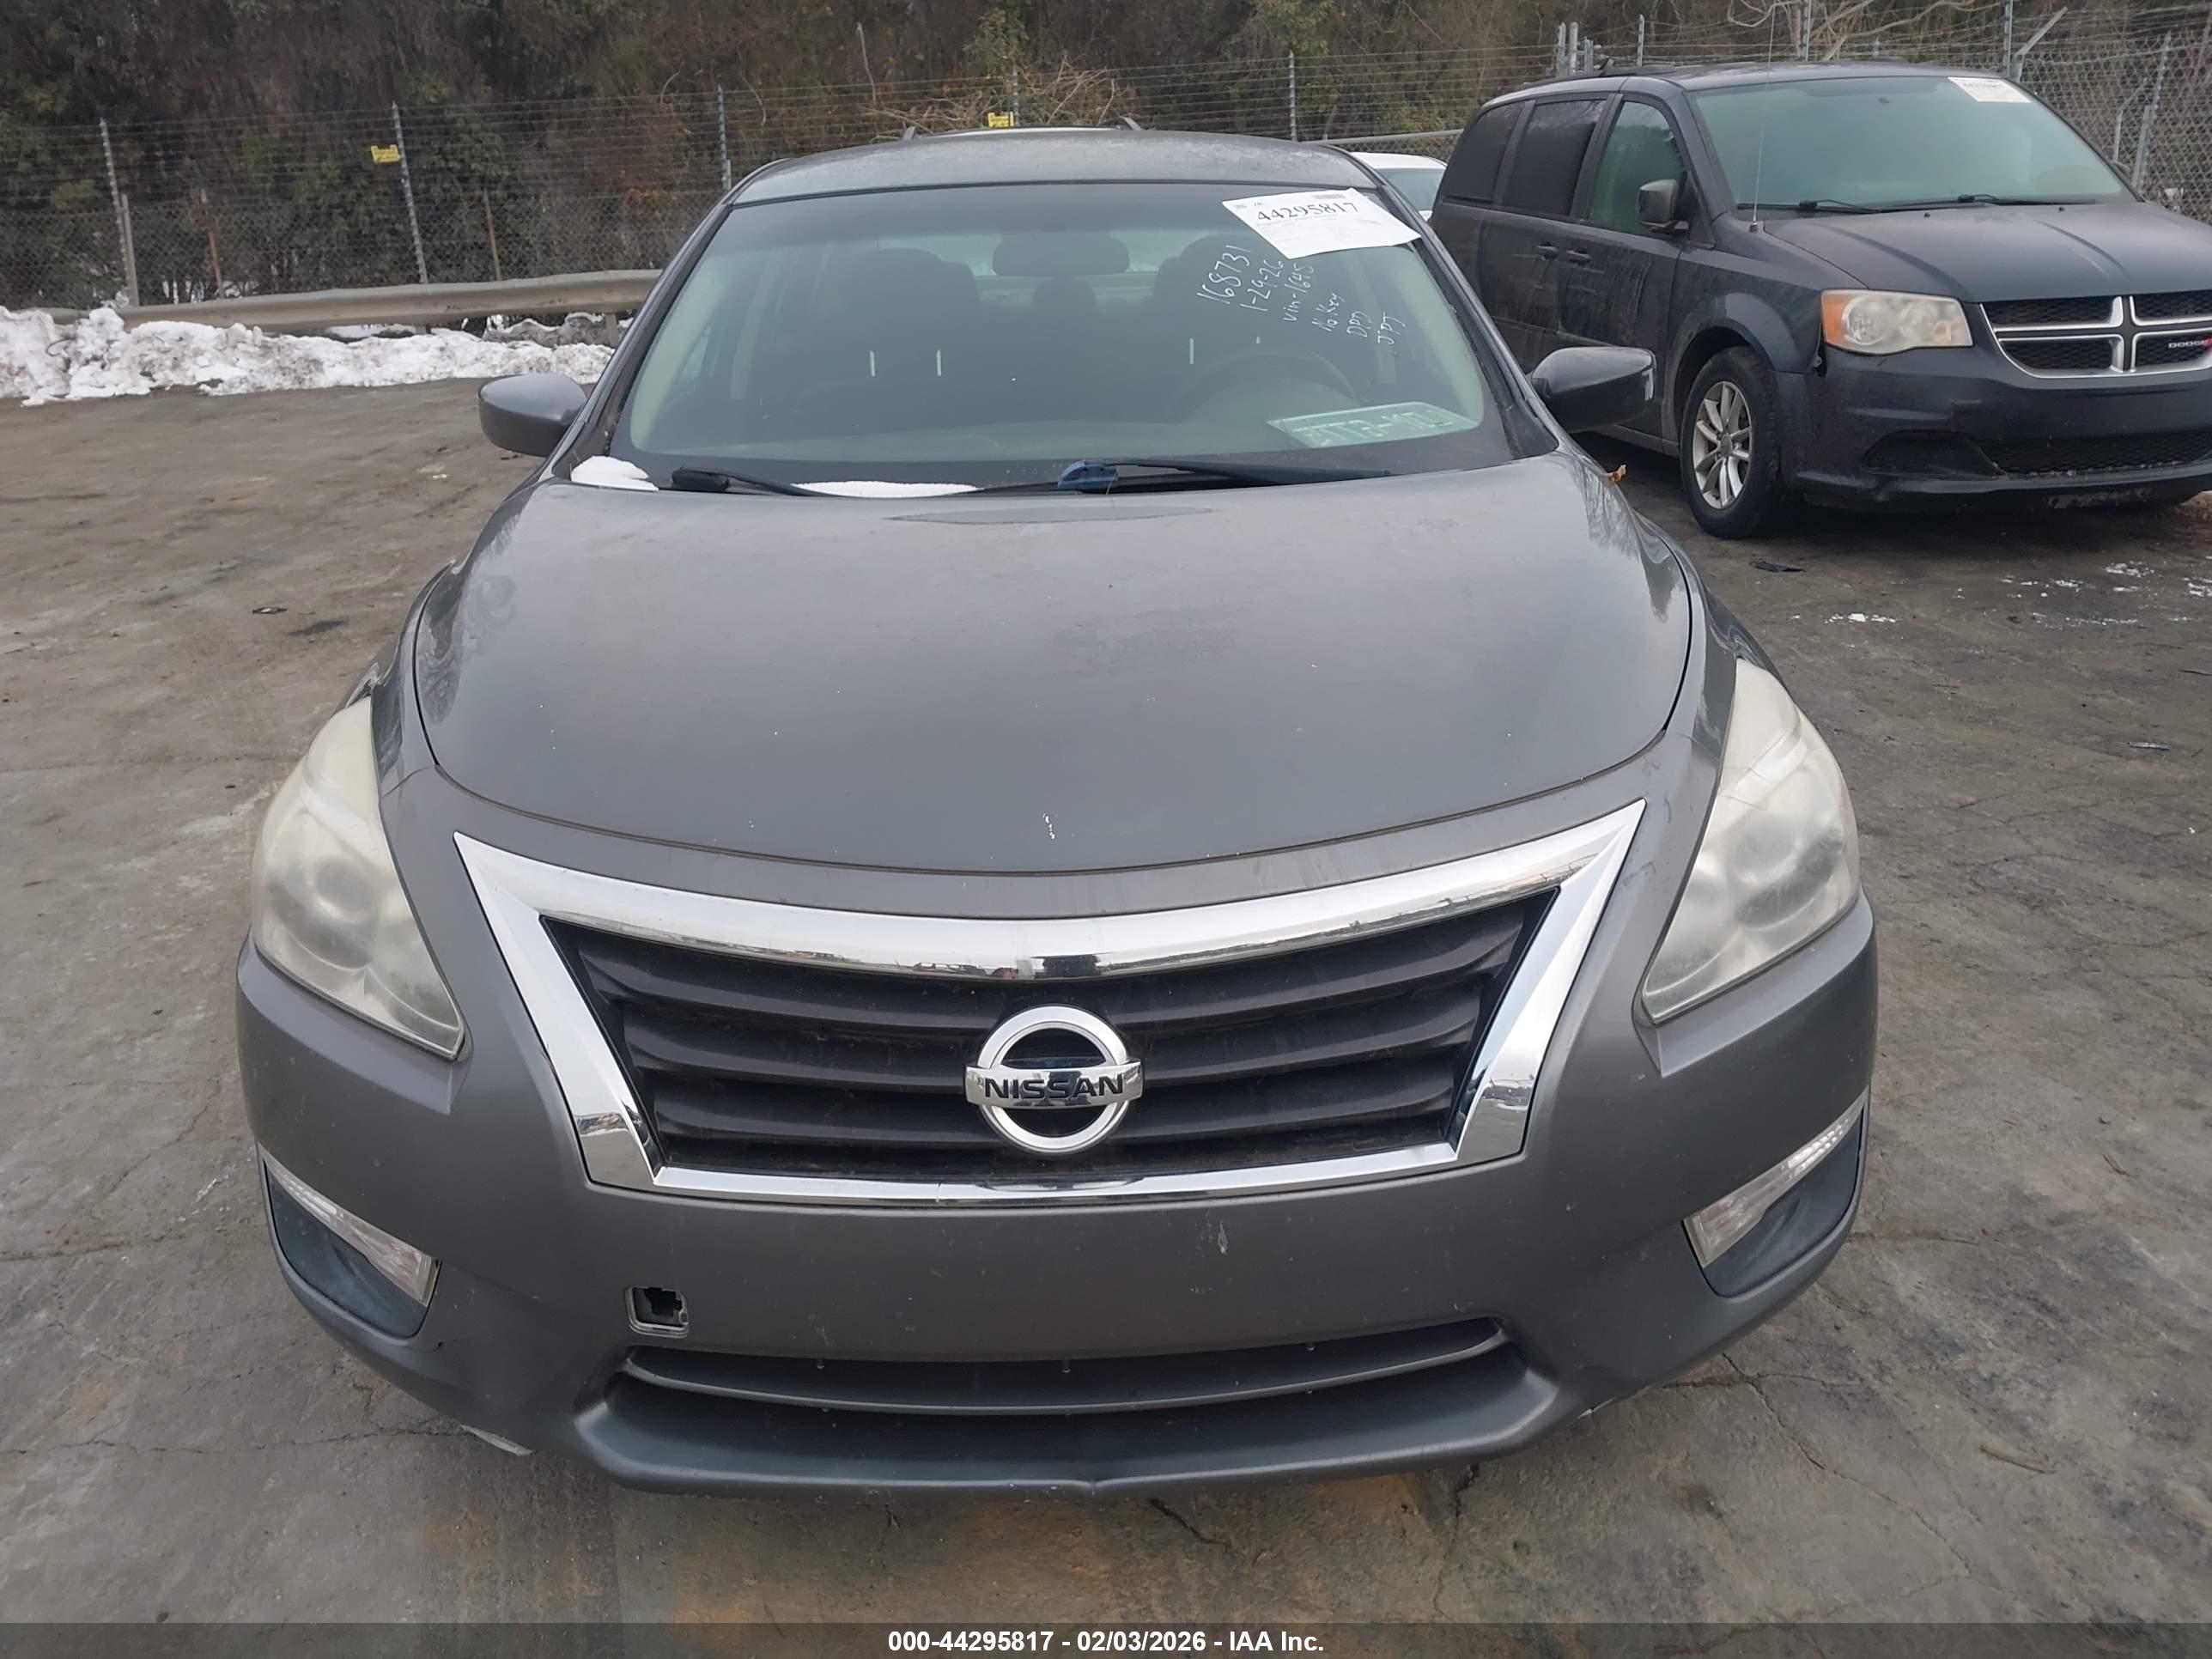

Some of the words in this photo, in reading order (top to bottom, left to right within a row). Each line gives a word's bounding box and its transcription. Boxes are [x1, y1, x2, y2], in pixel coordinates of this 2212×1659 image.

[1257, 202, 1359, 222] 44295817
[1196, 244, 1252, 305] 168731
[2167, 339, 2207, 349] DODGE
[984, 1073, 1124, 1099] NISSAN
